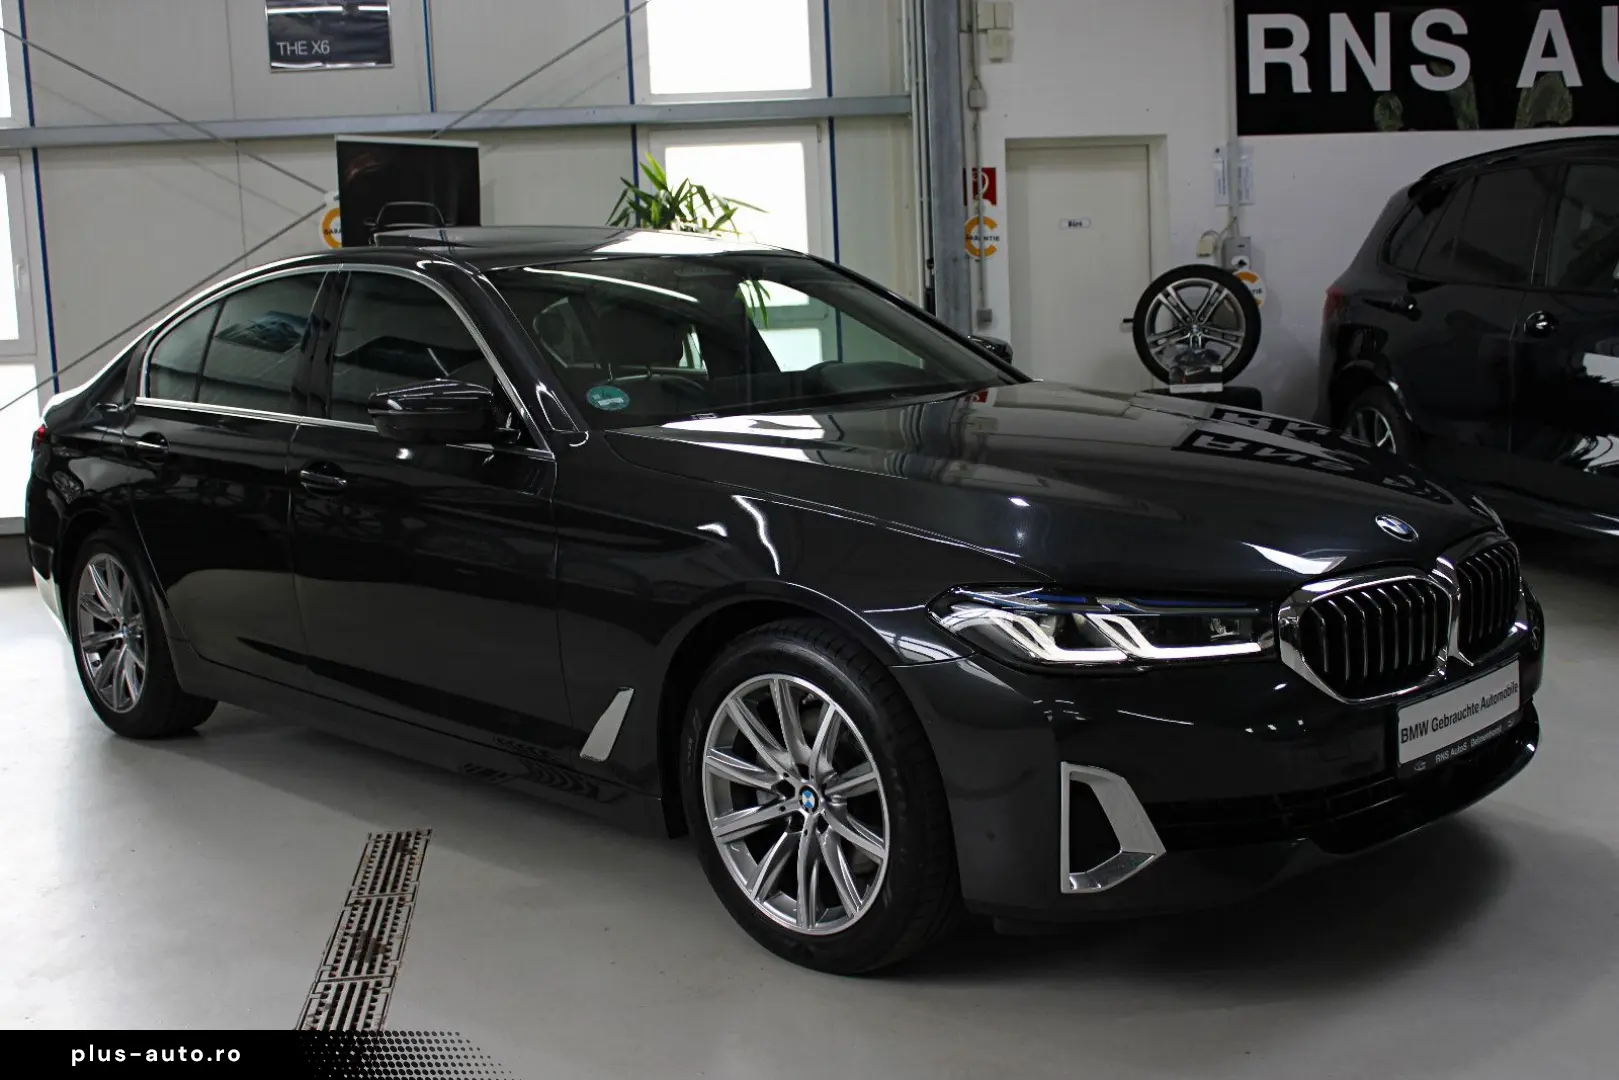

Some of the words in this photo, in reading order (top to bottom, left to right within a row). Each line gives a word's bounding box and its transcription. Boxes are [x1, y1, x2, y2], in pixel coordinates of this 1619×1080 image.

[276, 40, 309, 56] THE
[311, 39, 331, 55] X6
[1247, 8, 1471, 94] RNS
[1515, 5, 1619, 89] A
[1400, 719, 1429, 744] BMW
[1431, 701, 1480, 732] Gebrauchte
[1481, 680, 1519, 710] Automobile
[1435, 750, 1450, 764] RNS
